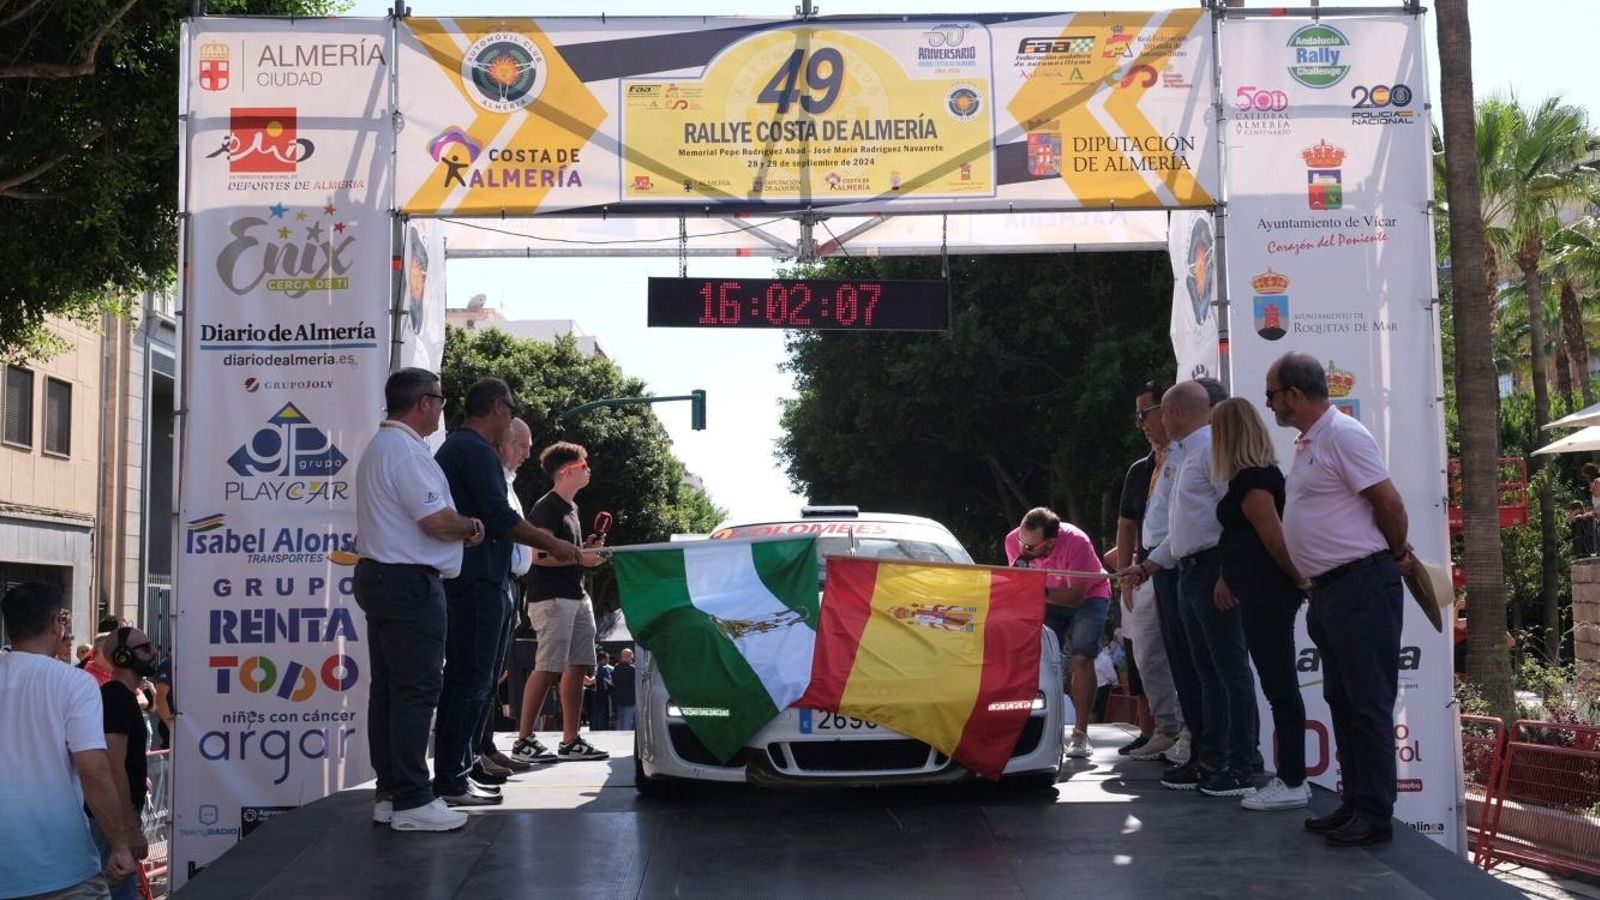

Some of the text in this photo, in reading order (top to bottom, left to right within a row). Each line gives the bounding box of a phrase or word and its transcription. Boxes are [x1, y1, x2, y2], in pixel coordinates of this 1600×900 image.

[258, 38, 386, 66] ALMERÍA
[918, 46, 976, 60] ANIVERSARIO
[1296, 47, 1340, 66] Rally
[257, 72, 323, 87] CIUDAD
[757, 47, 846, 115] 49
[1296, 66, 1341, 76] Challenge
[1235, 86, 1288, 112] 500
[1350, 84, 1413, 109] 200
[1235, 112, 1289, 120] CATEDRAL
[684, 113, 938, 144] RALLYE COSTA DE ALMERÍA
[679, 148, 717, 157] Memorial
[720, 148, 740, 158] Pepe
[785, 146, 806, 156] Abad
[813, 146, 831, 155] José
[904, 144, 944, 153] Navarrete
[1073, 132, 1195, 153] DIPUTACIÓN
[489, 148, 581, 164] COSTA DE
[747, 160, 758, 168] 28
[767, 160, 778, 168] 29
[780, 160, 790, 168] de
[792, 159, 839, 169] septiembre
[841, 158, 852, 167] de
[853, 157, 875, 167] 2024
[1073, 152, 1191, 173] DE ALMERÍA
[227, 181, 291, 191] DEPORTES
[294, 181, 310, 190] DE
[469, 164, 583, 189] ALMERÍA
[1257, 216, 1342, 233] Ayuntamiento
[1345, 215, 1360, 229] de
[1267, 231, 1389, 256] Corazón del Poniente
[216, 216, 357, 299] Enix
[268, 279, 349, 290] CERCA DE TI
[699, 282, 881, 327] 16:02:07
[1294, 312, 1364, 321] AYUNTAMIENTO DE
[200, 320, 376, 342] Diario de Almería
[223, 353, 355, 367] diariodealmeria.es
[299, 459, 342, 470] grupo
[224, 480, 350, 504] PLAYCAR
[186, 527, 265, 554] Isabel
[247, 553, 324, 564] TRANSPORTES
[213, 577, 355, 597] GRUPO
[209, 608, 359, 644] RENTA
[209, 653, 360, 703] TODO
[222, 709, 356, 725] niños con cáncer
[199, 728, 356, 785] argar
